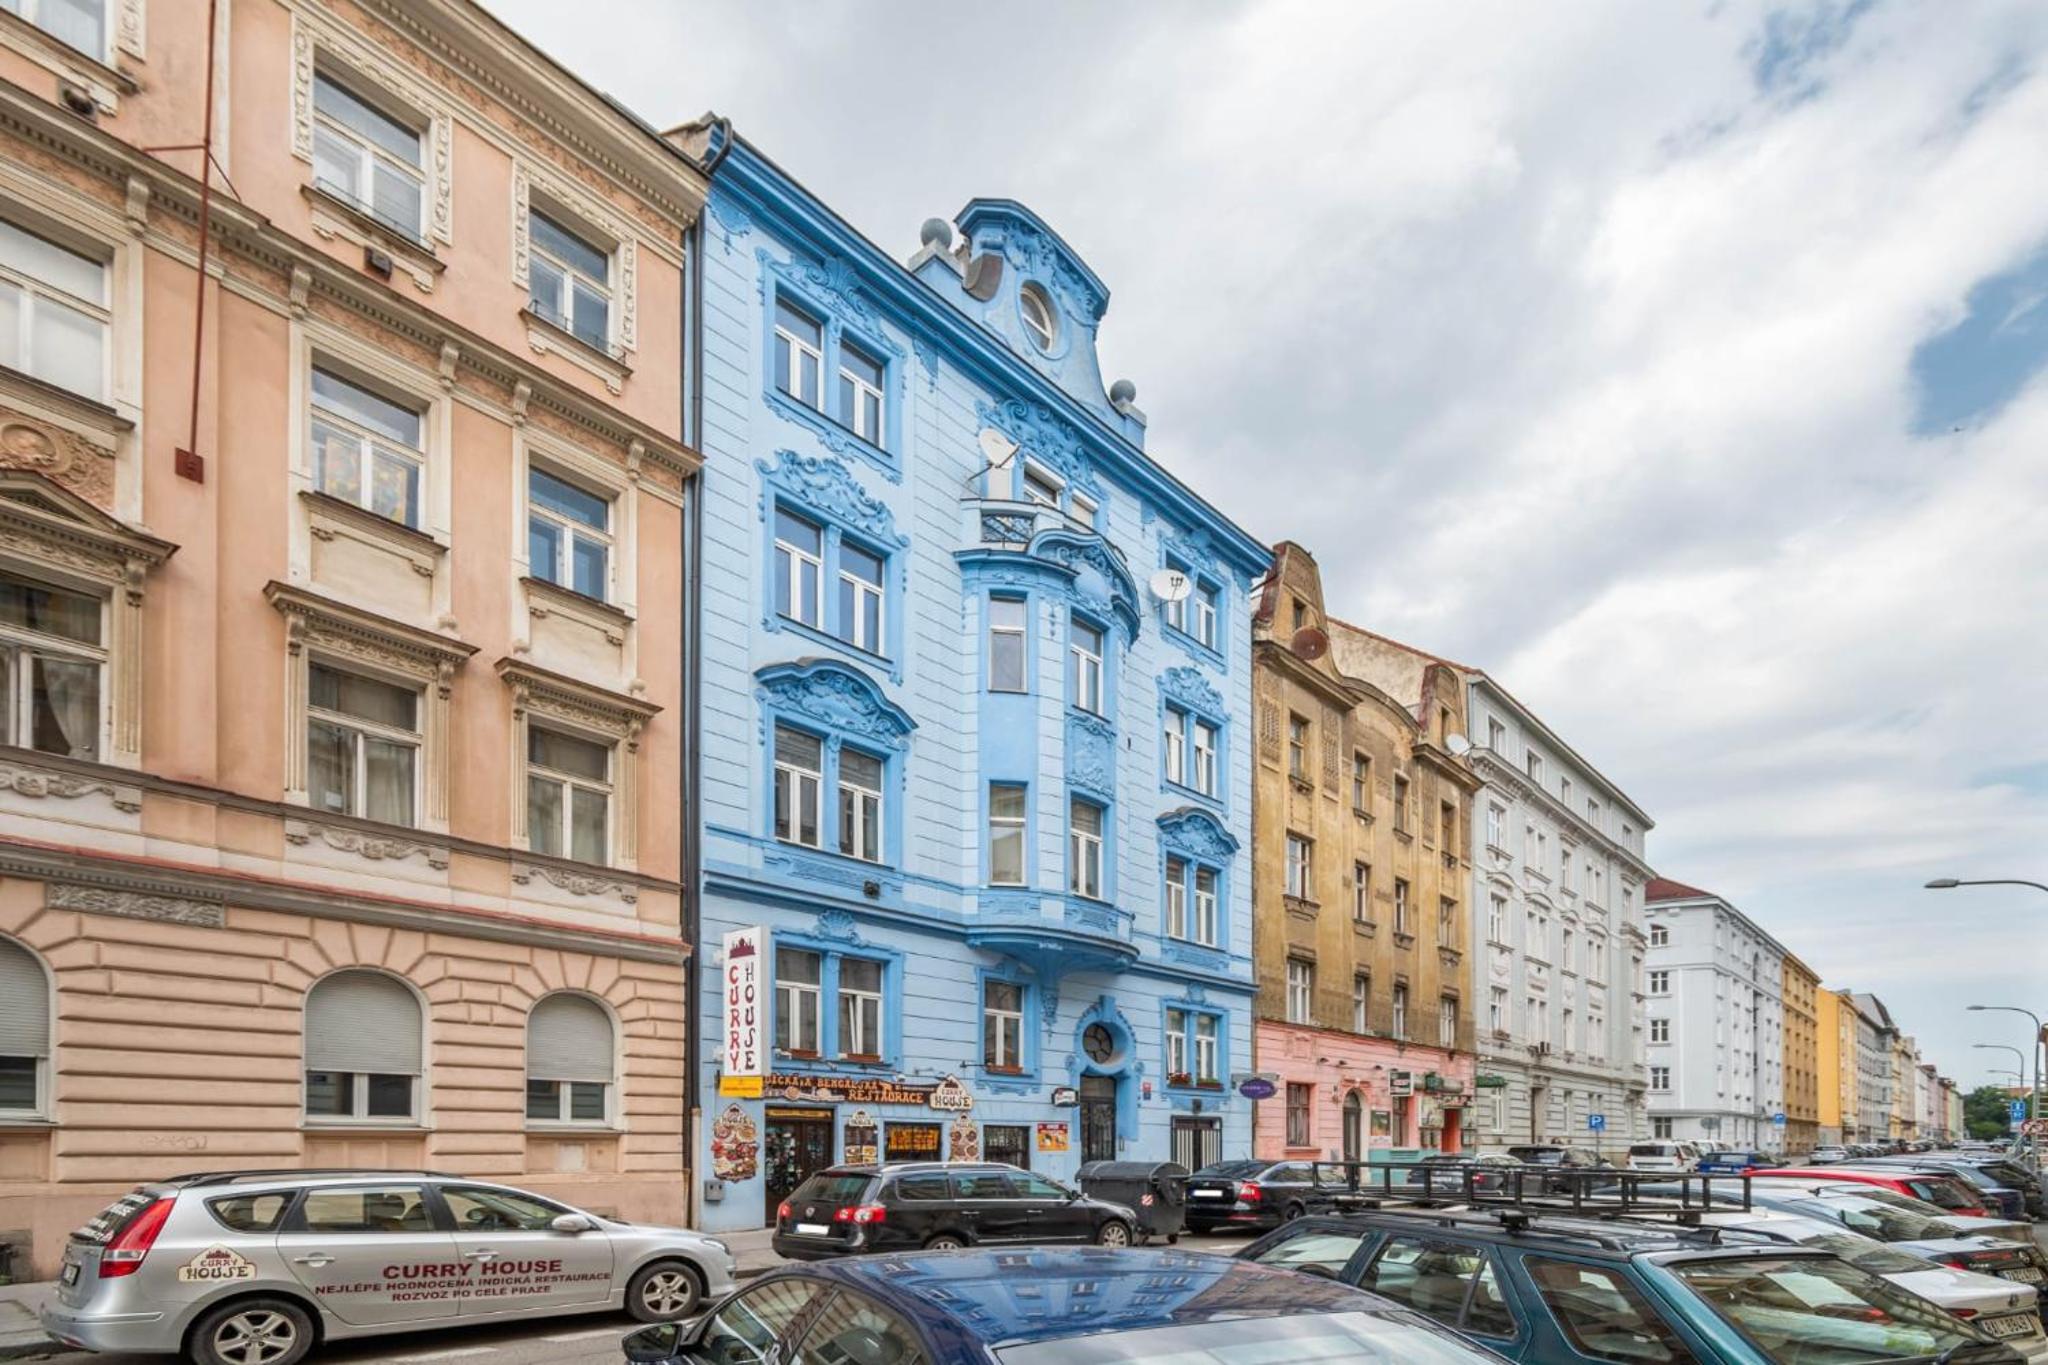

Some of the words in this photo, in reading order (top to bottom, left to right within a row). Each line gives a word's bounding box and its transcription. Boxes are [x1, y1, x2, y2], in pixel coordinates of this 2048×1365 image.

[729, 965, 740, 1071] CURRY
[744, 961, 756, 1070] HOUSE
[848, 1089, 924, 1103] RESTAURACE
[934, 1095, 970, 1107] HOUSE
[1591, 1116, 1602, 1127] P
[200, 1258, 238, 1267] CURRY
[186, 1266, 249, 1279] HOUSE
[383, 1263, 472, 1279] CURRY
[481, 1260, 562, 1275] HOUSE
[535, 1272, 612, 1283] RESTAURACE
[392, 1290, 449, 1302] ROZVOZ
[453, 1288, 470, 1298] PO
[511, 1285, 550, 1295] PRAZE
